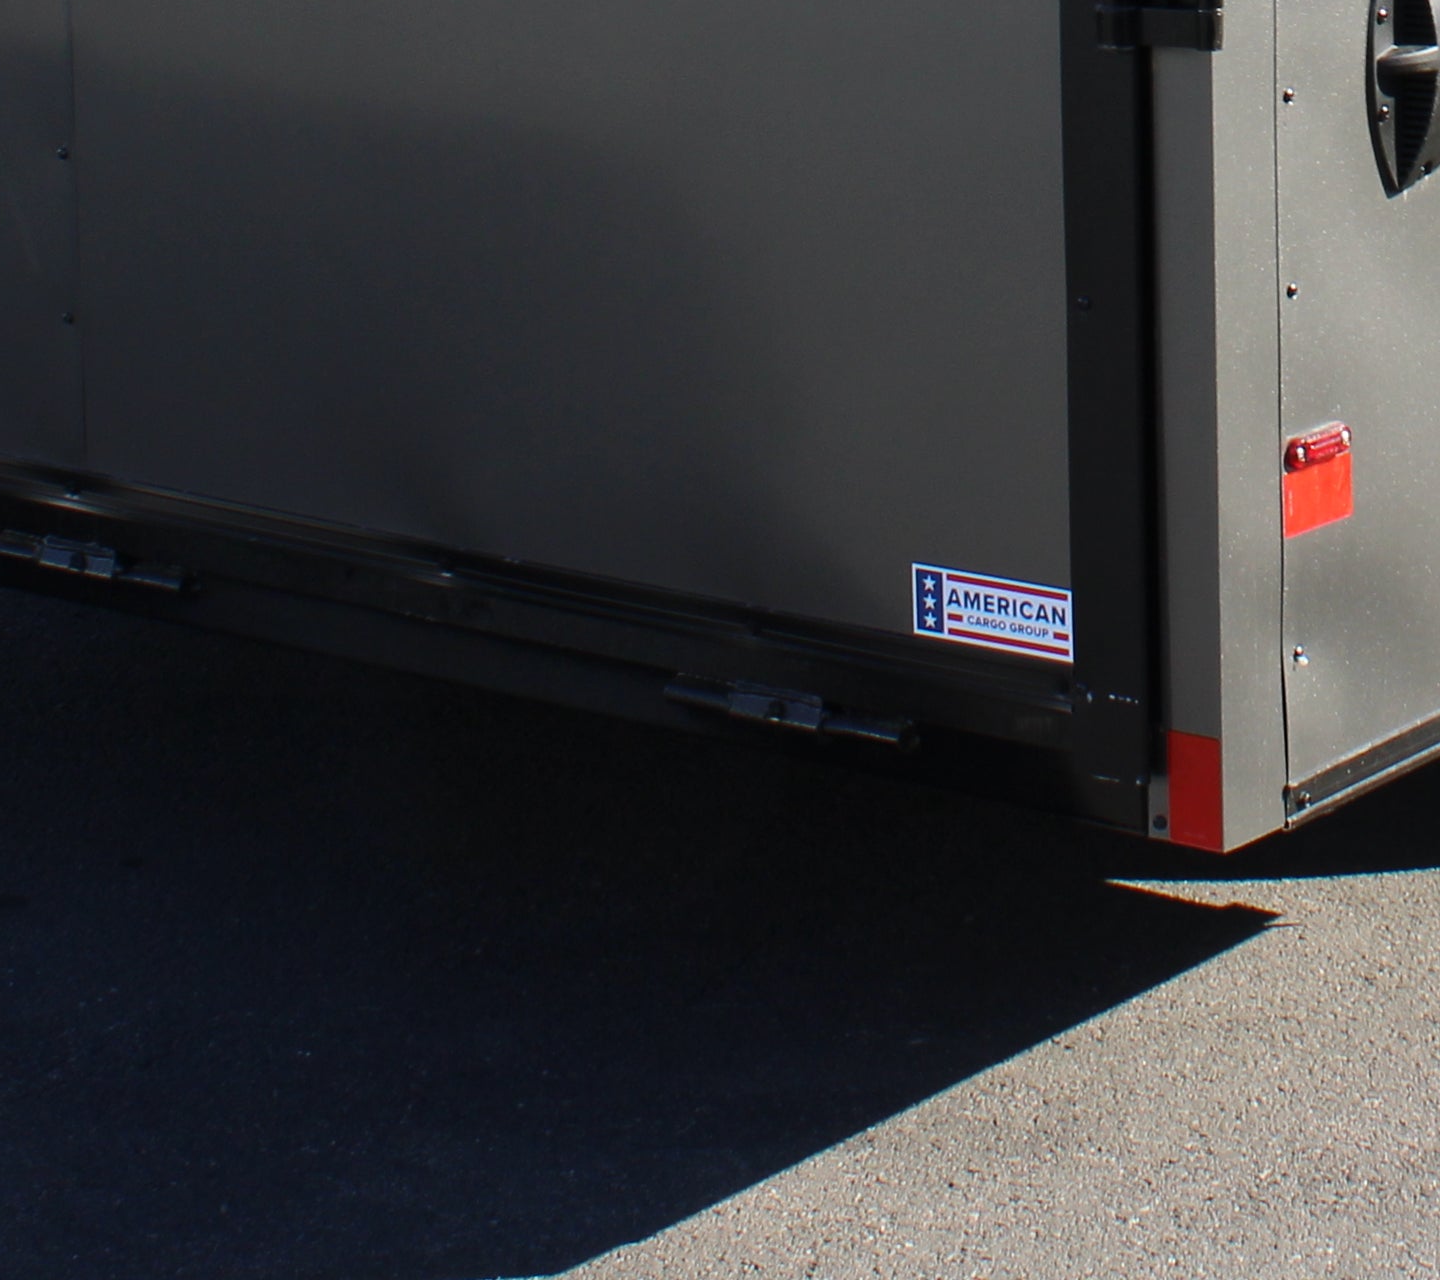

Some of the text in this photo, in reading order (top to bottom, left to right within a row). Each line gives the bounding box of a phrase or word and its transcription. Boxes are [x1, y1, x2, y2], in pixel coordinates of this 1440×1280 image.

[947, 589, 1066, 625] AMERICAN
[967, 615, 1049, 638] CARGO GROUP
